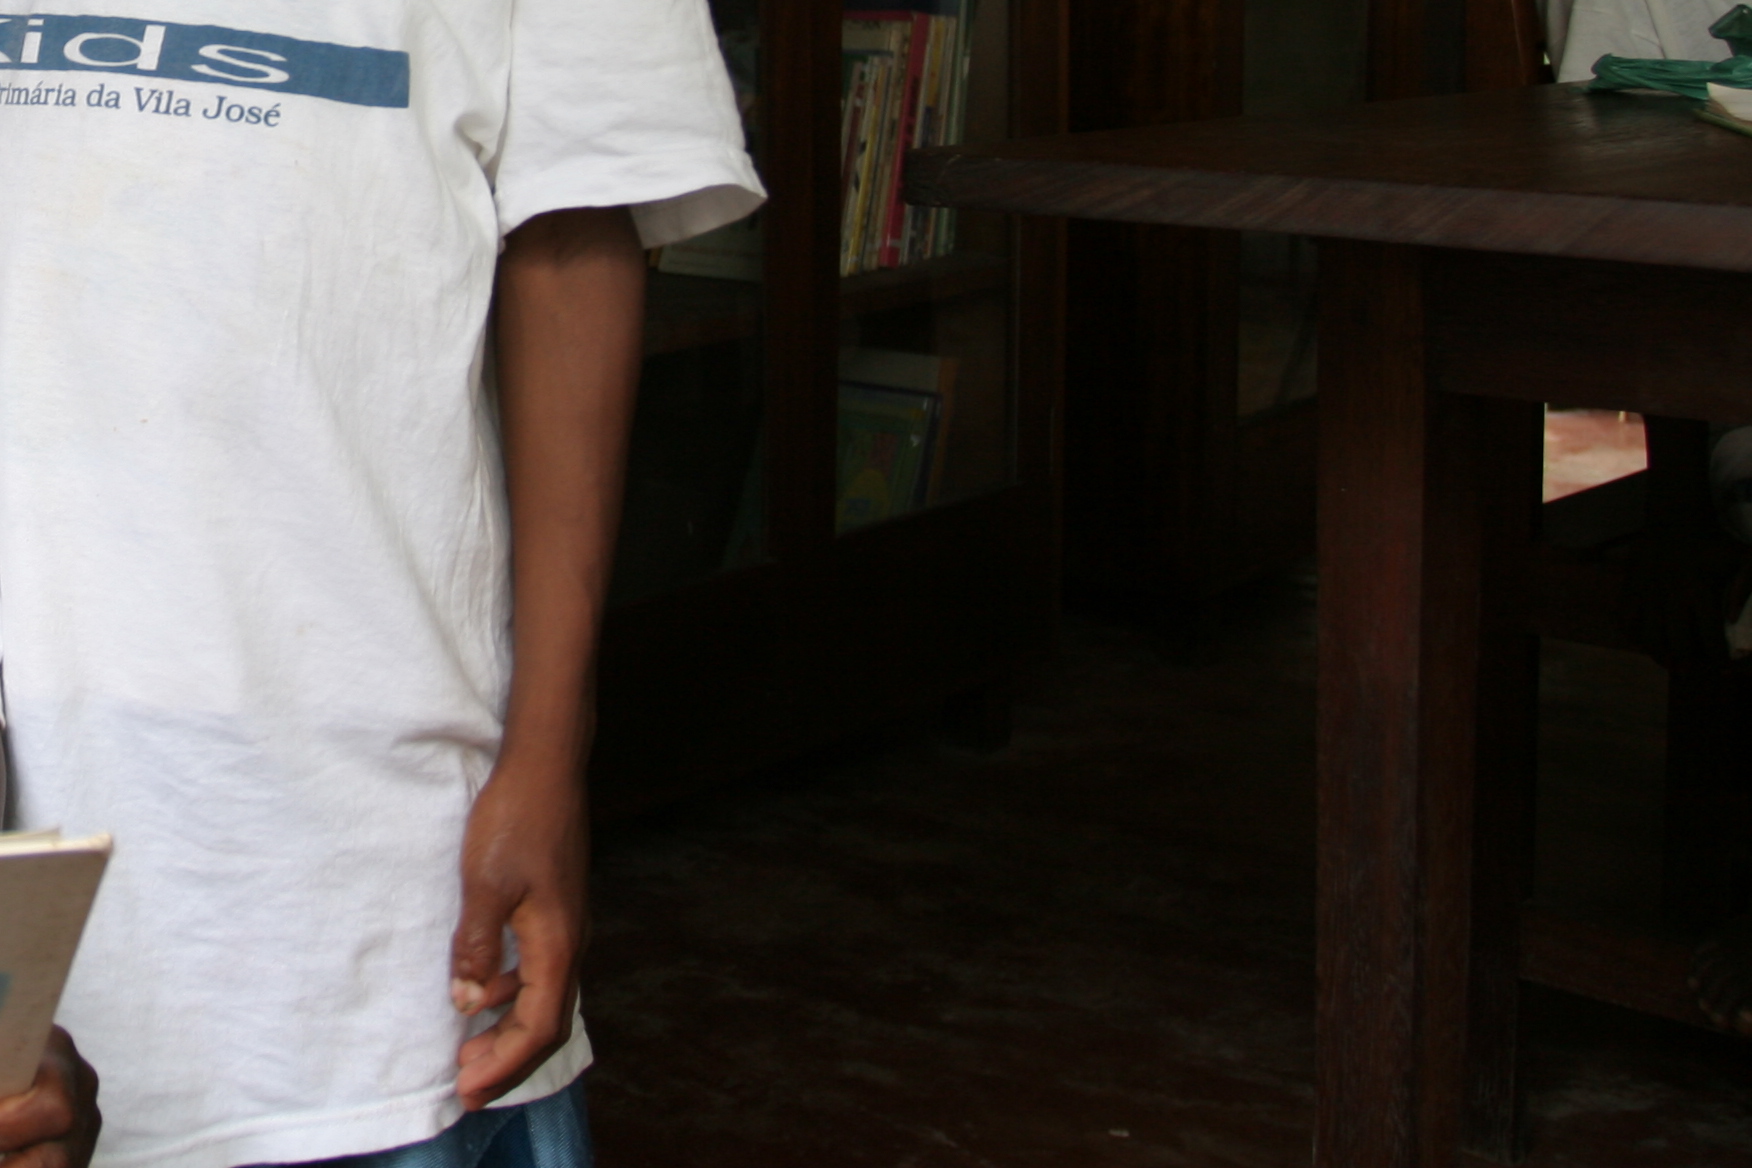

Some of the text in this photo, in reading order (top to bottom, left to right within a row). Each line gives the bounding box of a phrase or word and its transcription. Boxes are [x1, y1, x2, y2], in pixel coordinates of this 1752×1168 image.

[86, 82, 122, 111] da
[134, 86, 192, 118] Vila
[202, 95, 281, 129] José
